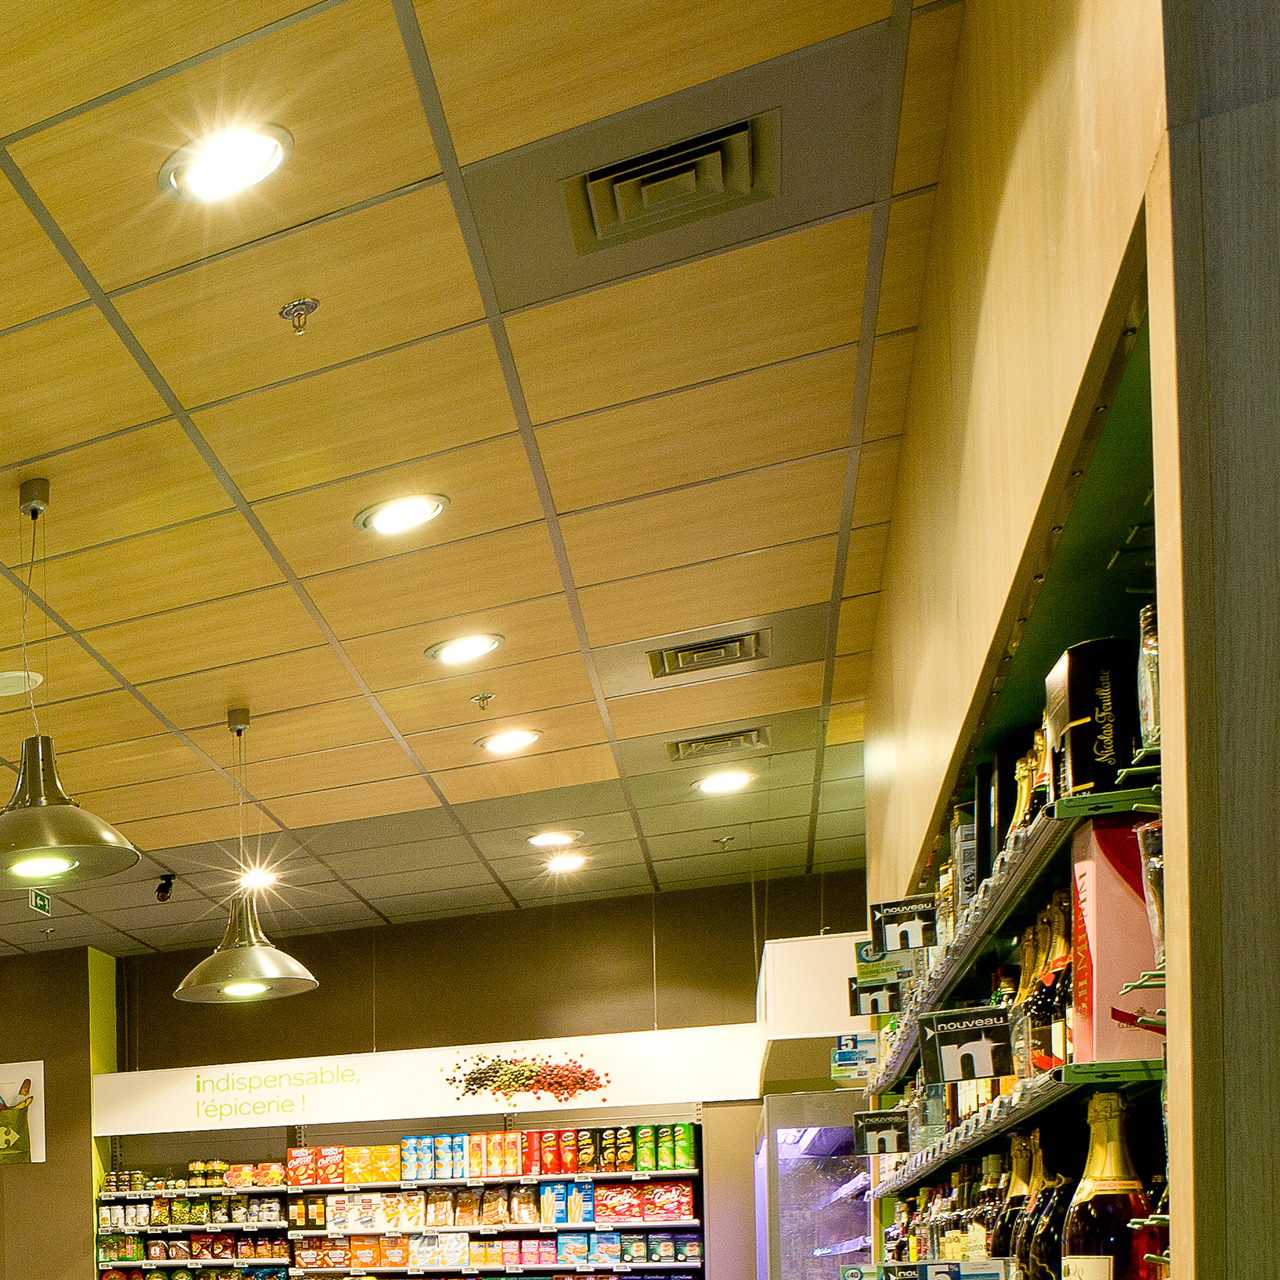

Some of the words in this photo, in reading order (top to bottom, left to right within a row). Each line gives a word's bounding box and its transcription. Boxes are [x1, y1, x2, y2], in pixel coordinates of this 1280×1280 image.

[883, 902, 932, 915] nouveau
[937, 1016, 1004, 1031] nouveau
[196, 1065, 360, 1094] indispensable,
[196, 1095, 295, 1121] l'épicerie
